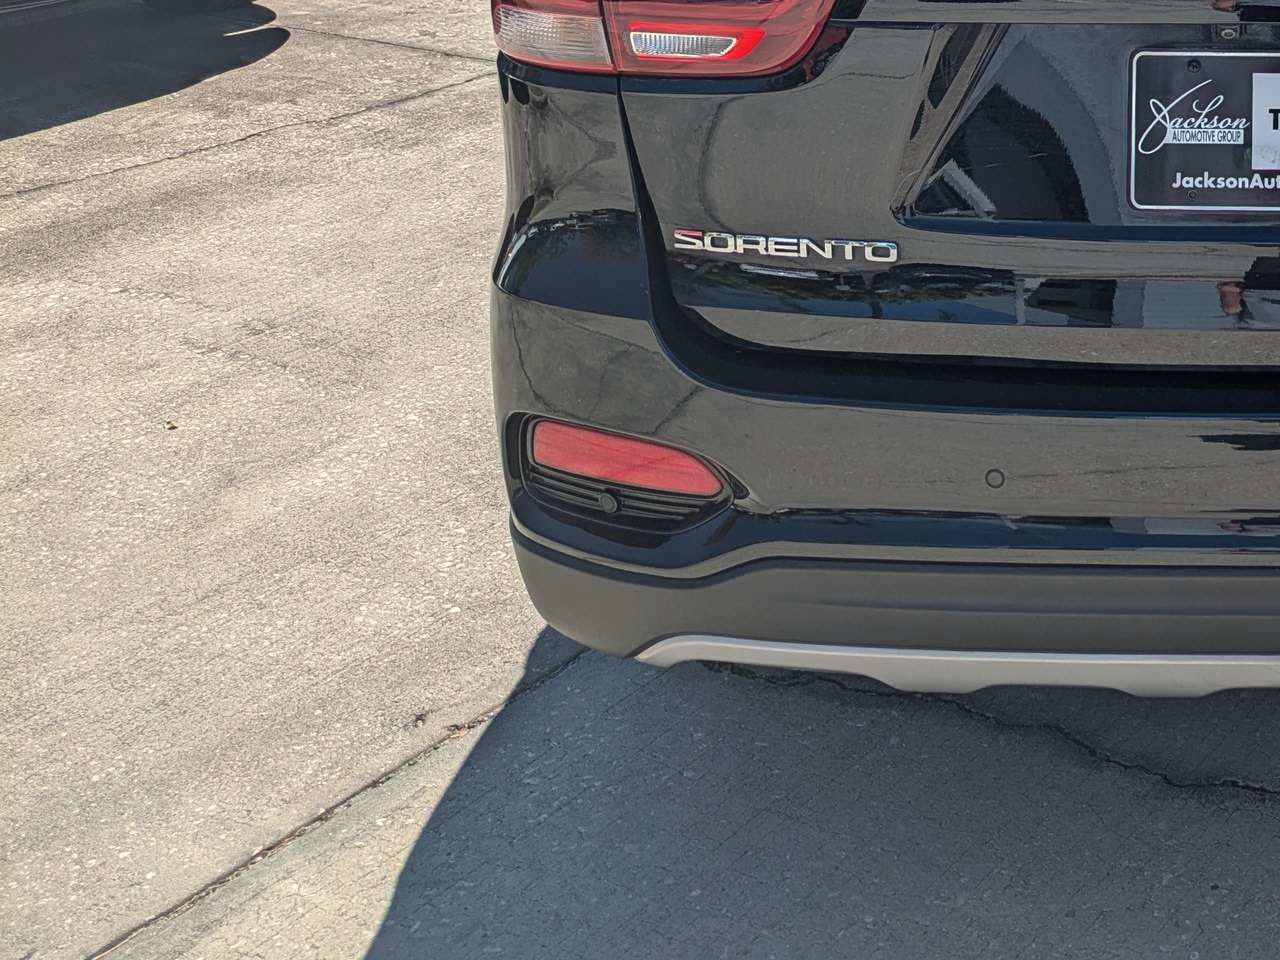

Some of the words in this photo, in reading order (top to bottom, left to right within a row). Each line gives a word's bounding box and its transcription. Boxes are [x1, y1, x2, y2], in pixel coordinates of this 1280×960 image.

[1138, 79, 1250, 155] Jackson
[1172, 129, 1215, 143] AUTOMOTIVE
[1216, 130, 1241, 144] GROUP
[674, 228, 898, 263] SORENTO
